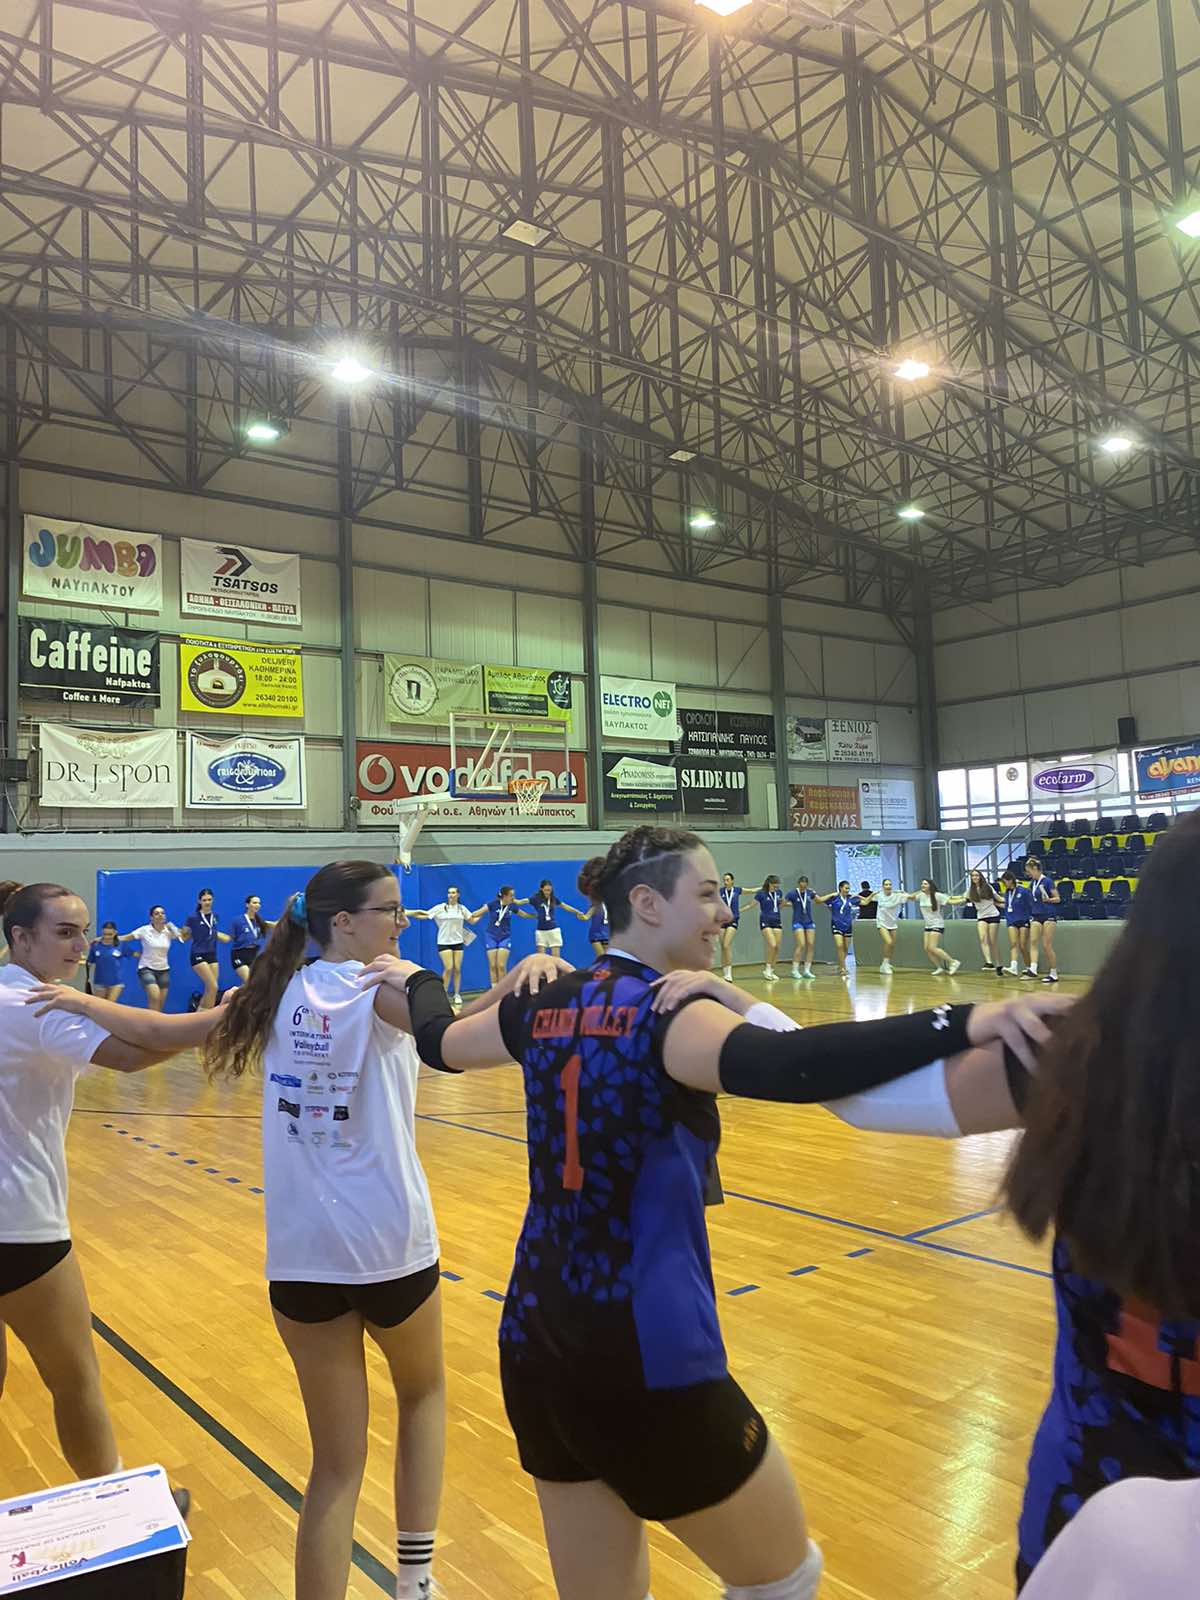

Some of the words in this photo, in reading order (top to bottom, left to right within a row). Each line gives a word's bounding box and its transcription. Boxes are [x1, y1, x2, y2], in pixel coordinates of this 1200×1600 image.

[29, 529, 156, 577] JUMBO
[213, 576, 278, 594] TSATSOS
[30, 628, 152, 677] Caffeine
[261, 657, 296, 666] DELIVERY
[248, 666, 297, 674] ΚΑΘΗΜΕΡΙΝΑ
[105, 677, 151, 689] Nafpaktos
[63, 692, 90, 701] Coffee
[99, 695, 121, 704] More
[255, 694, 276, 702] 26340
[277, 695, 298, 703] 20100
[603, 693, 651, 709] ELECTRO
[654, 698, 671, 710] NET
[831, 719, 872, 734] ΞΕΝΙΟΣ
[46, 761, 86, 783] DR.
[90, 763, 102, 794] J.
[400, 757, 577, 797] vodafone
[681, 769, 723, 788] SLIDE
[1038, 771, 1087, 785] ecofarm
[443, 807, 462, 816] ο.ε.
[469, 806, 506, 817] Αθηνών
[510, 806, 520, 816] 11
[294, 1040, 329, 1053] Volleyball
[559, 1055, 585, 1191] 1
[12, 1557, 89, 1582] Volleyball
